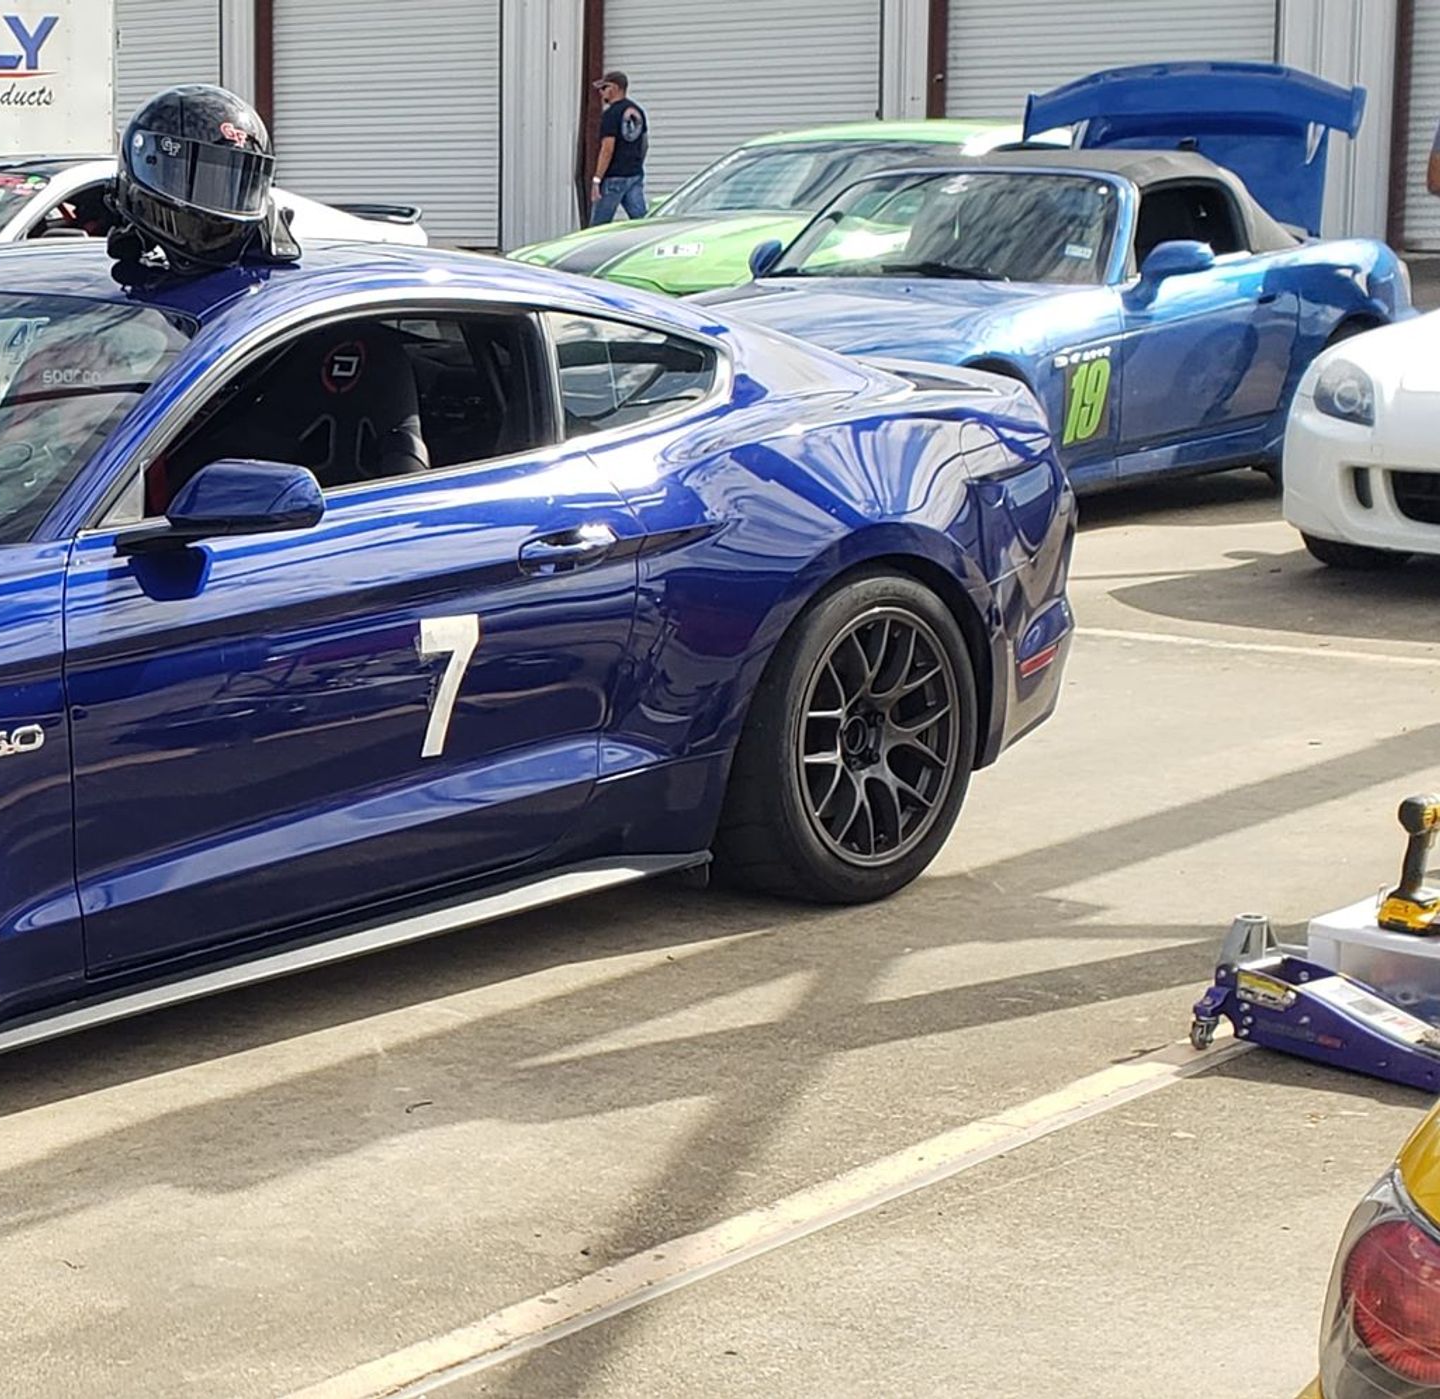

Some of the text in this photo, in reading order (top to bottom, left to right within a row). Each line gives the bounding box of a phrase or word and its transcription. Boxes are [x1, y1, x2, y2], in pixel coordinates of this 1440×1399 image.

[42, 368, 101, 384] sparco
[1062, 358, 1111, 446] 19
[420, 613, 479, 758] 7
